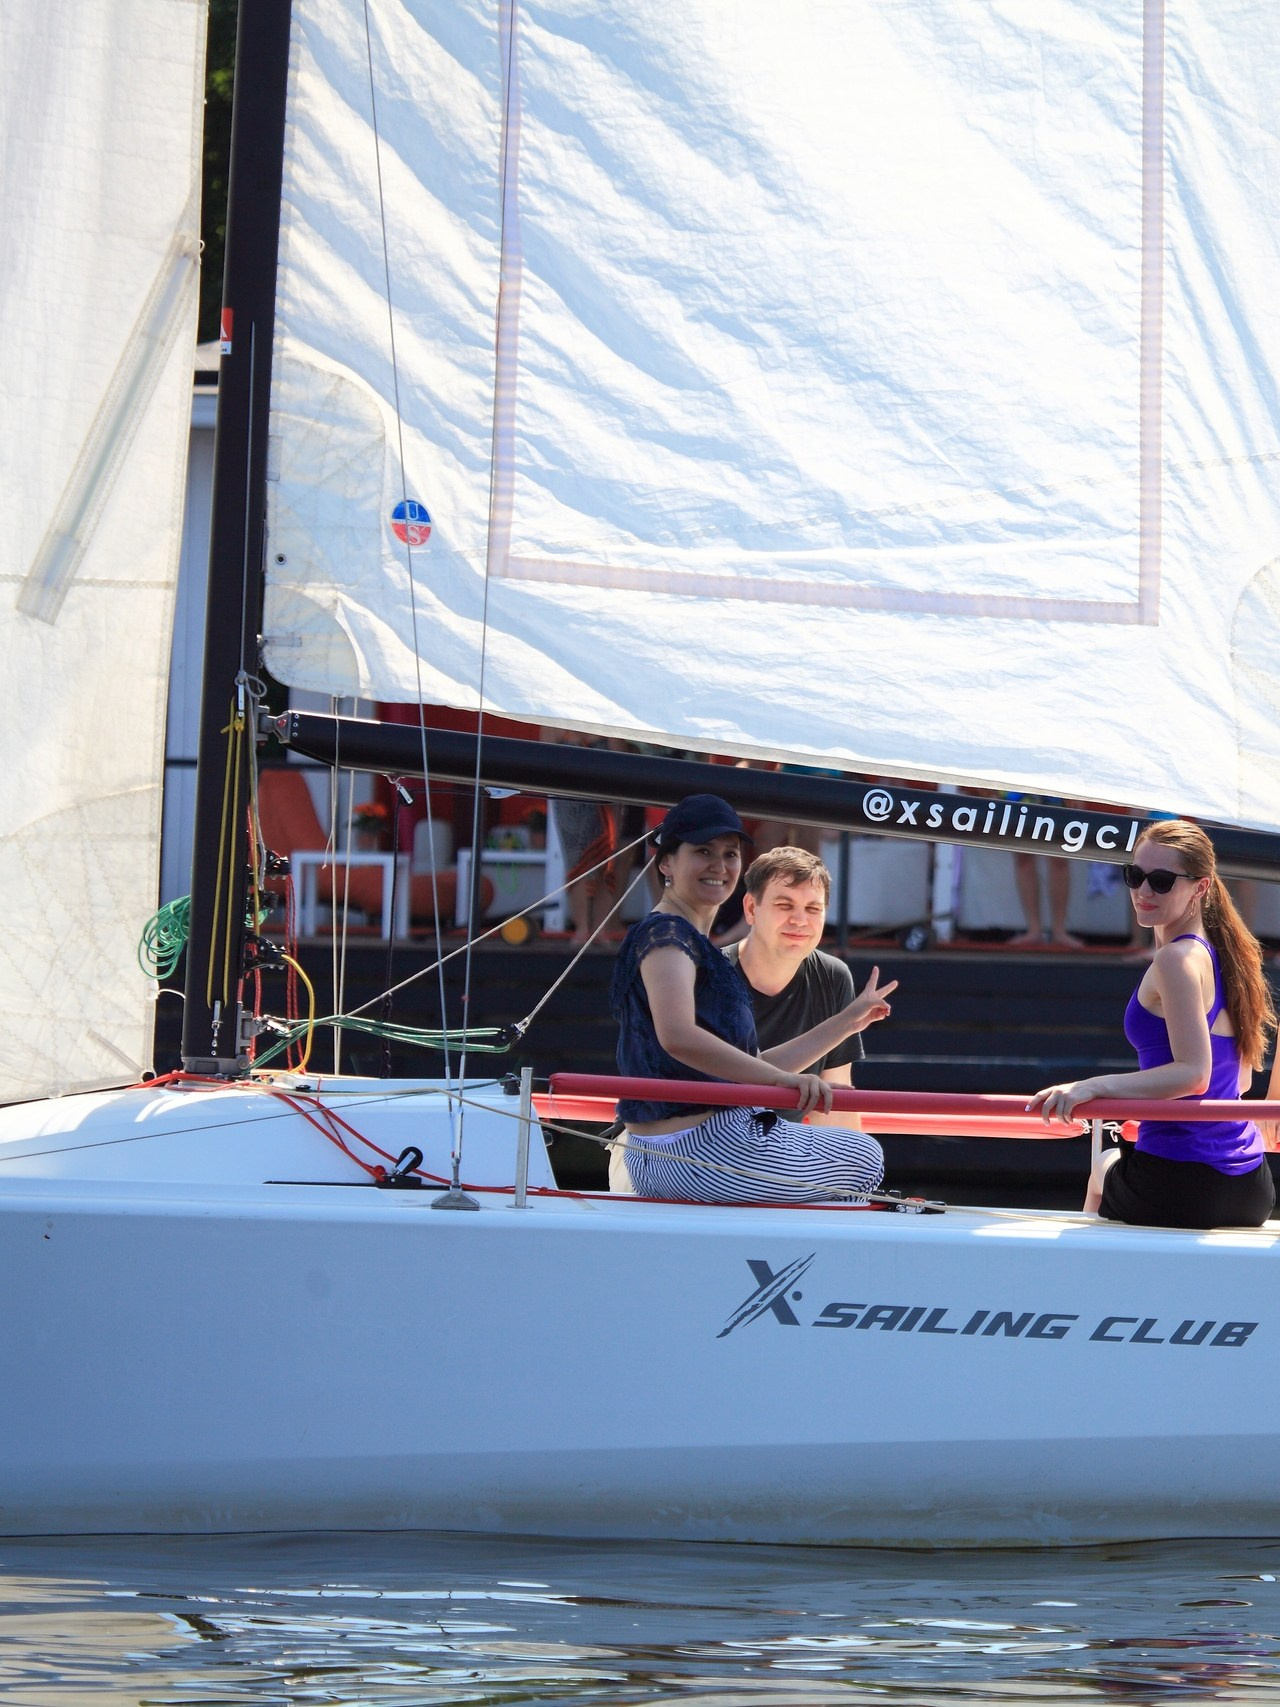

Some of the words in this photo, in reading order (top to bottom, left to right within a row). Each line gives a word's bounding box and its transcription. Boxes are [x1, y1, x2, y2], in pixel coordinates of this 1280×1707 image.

[862, 789, 1139, 852] @xsailingcl
[811, 1302, 1080, 1340] SAILING
[1088, 1316, 1259, 1347] CLUB
